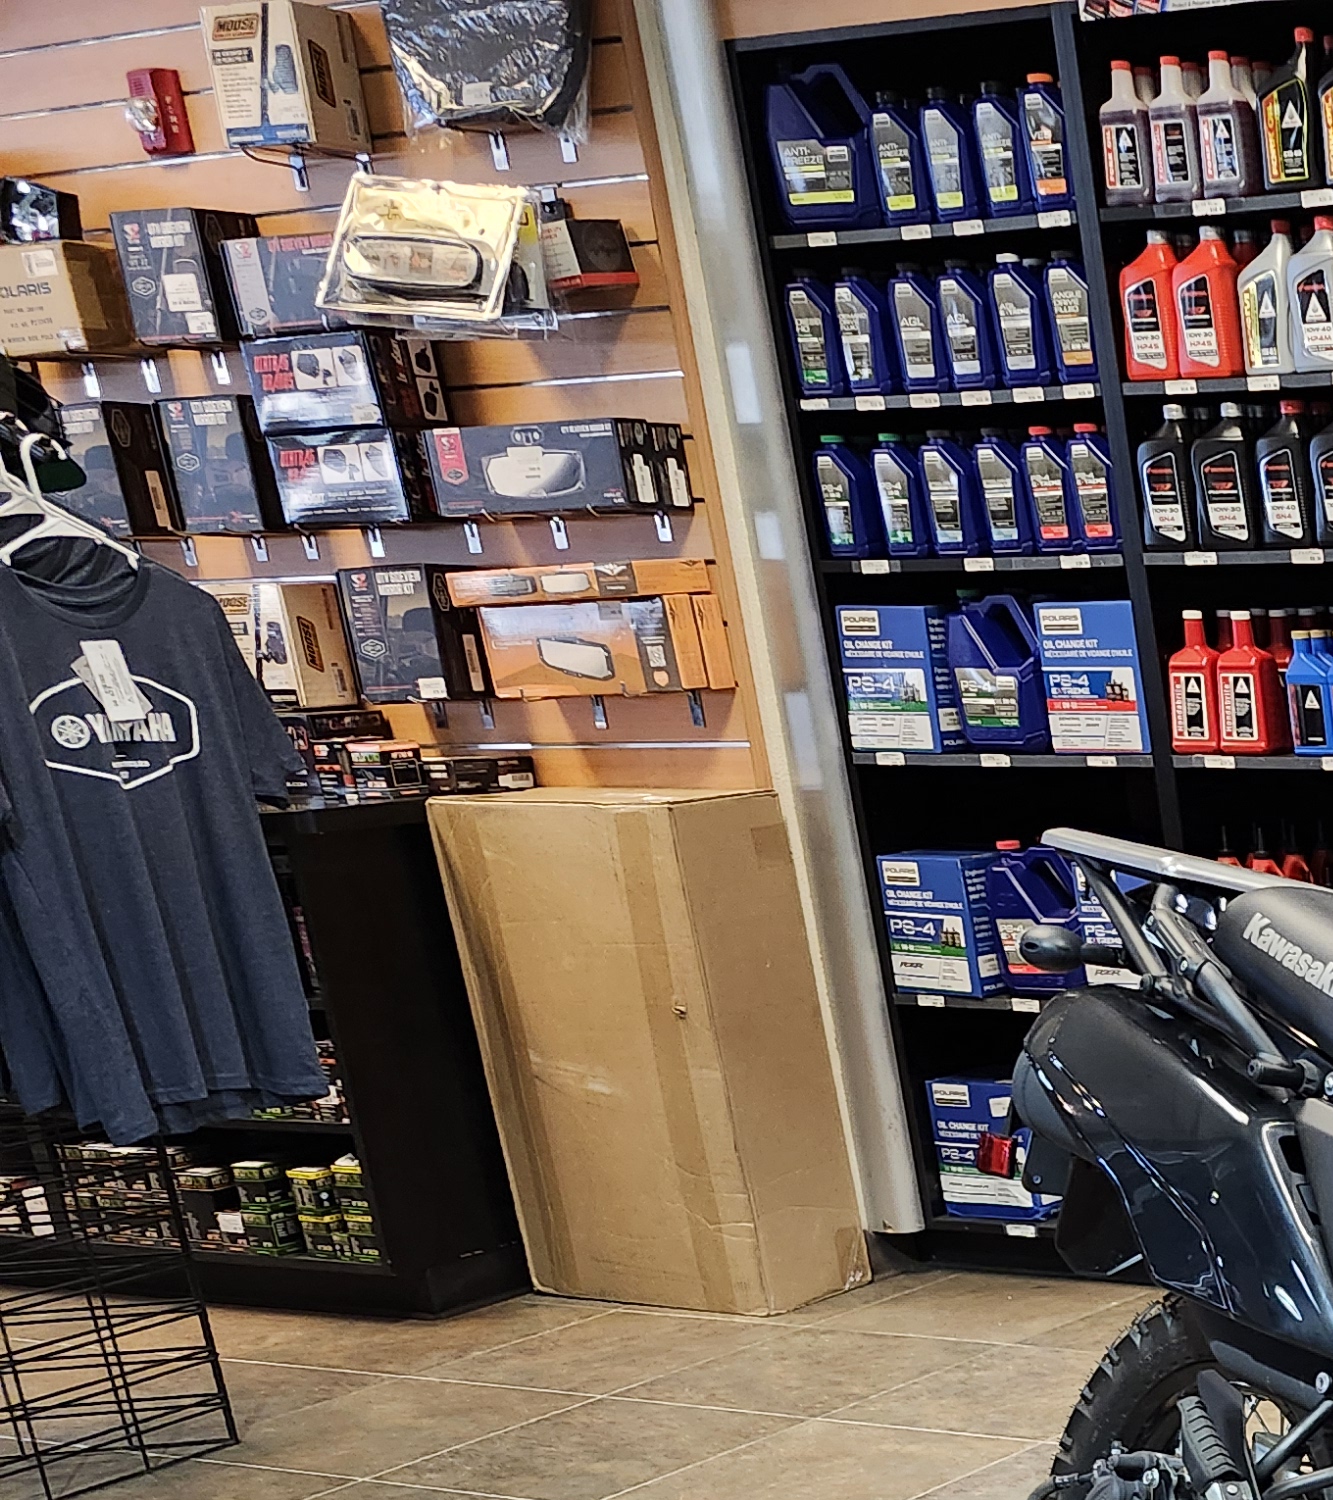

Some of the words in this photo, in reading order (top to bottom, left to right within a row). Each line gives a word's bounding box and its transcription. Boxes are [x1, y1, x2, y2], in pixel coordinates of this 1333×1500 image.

[0, 283, 51, 297] OLARIS
[1052, 291, 1082, 299] ANGLE
[900, 317, 924, 327] AGL
[843, 616, 876, 625] POLARIS
[1042, 614, 1078, 623] POLARIS
[848, 675, 895, 692] PS-4
[960, 680, 992, 692] PS-4
[1050, 674, 1089, 687] PS-4
[1176, 683, 1185, 732] Hondabrite
[889, 919, 936, 937] PS-4
